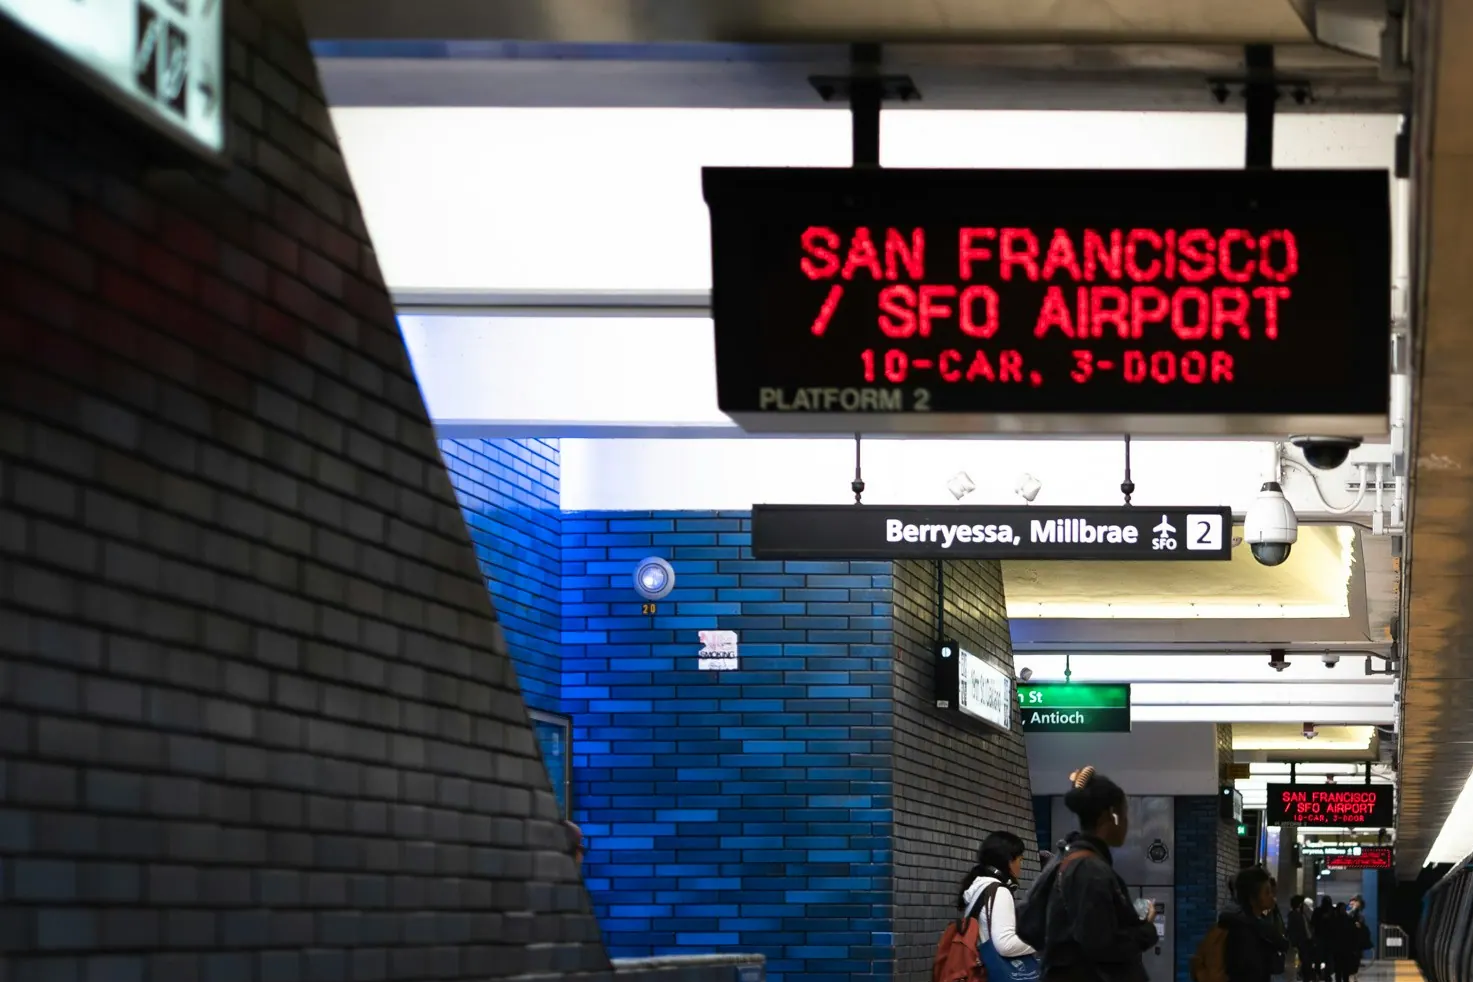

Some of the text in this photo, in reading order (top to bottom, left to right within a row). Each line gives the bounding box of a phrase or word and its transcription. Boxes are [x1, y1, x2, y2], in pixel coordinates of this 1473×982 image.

[800, 226, 1298, 282] SAN FRANCISCO
[810, 284, 1292, 340] / SFO AIRPORT
[860, 349, 1235, 388] 10-CAR, 3-DOOR
[759, 387, 931, 411] PLATFORM 2
[886, 519, 1139, 547] Berryessa, Millbrae
[1195, 521, 1214, 545] 2
[1151, 537, 1178, 550] SFO
[700, 650, 736, 659] SMOKING
[1029, 691, 1043, 703] St
[1030, 711, 1084, 724] Antioch
[1282, 791, 1377, 803] SAN FRANCISCO
[1297, 802, 1320, 813] SFO
[1326, 803, 1375, 814] AIRPORT
